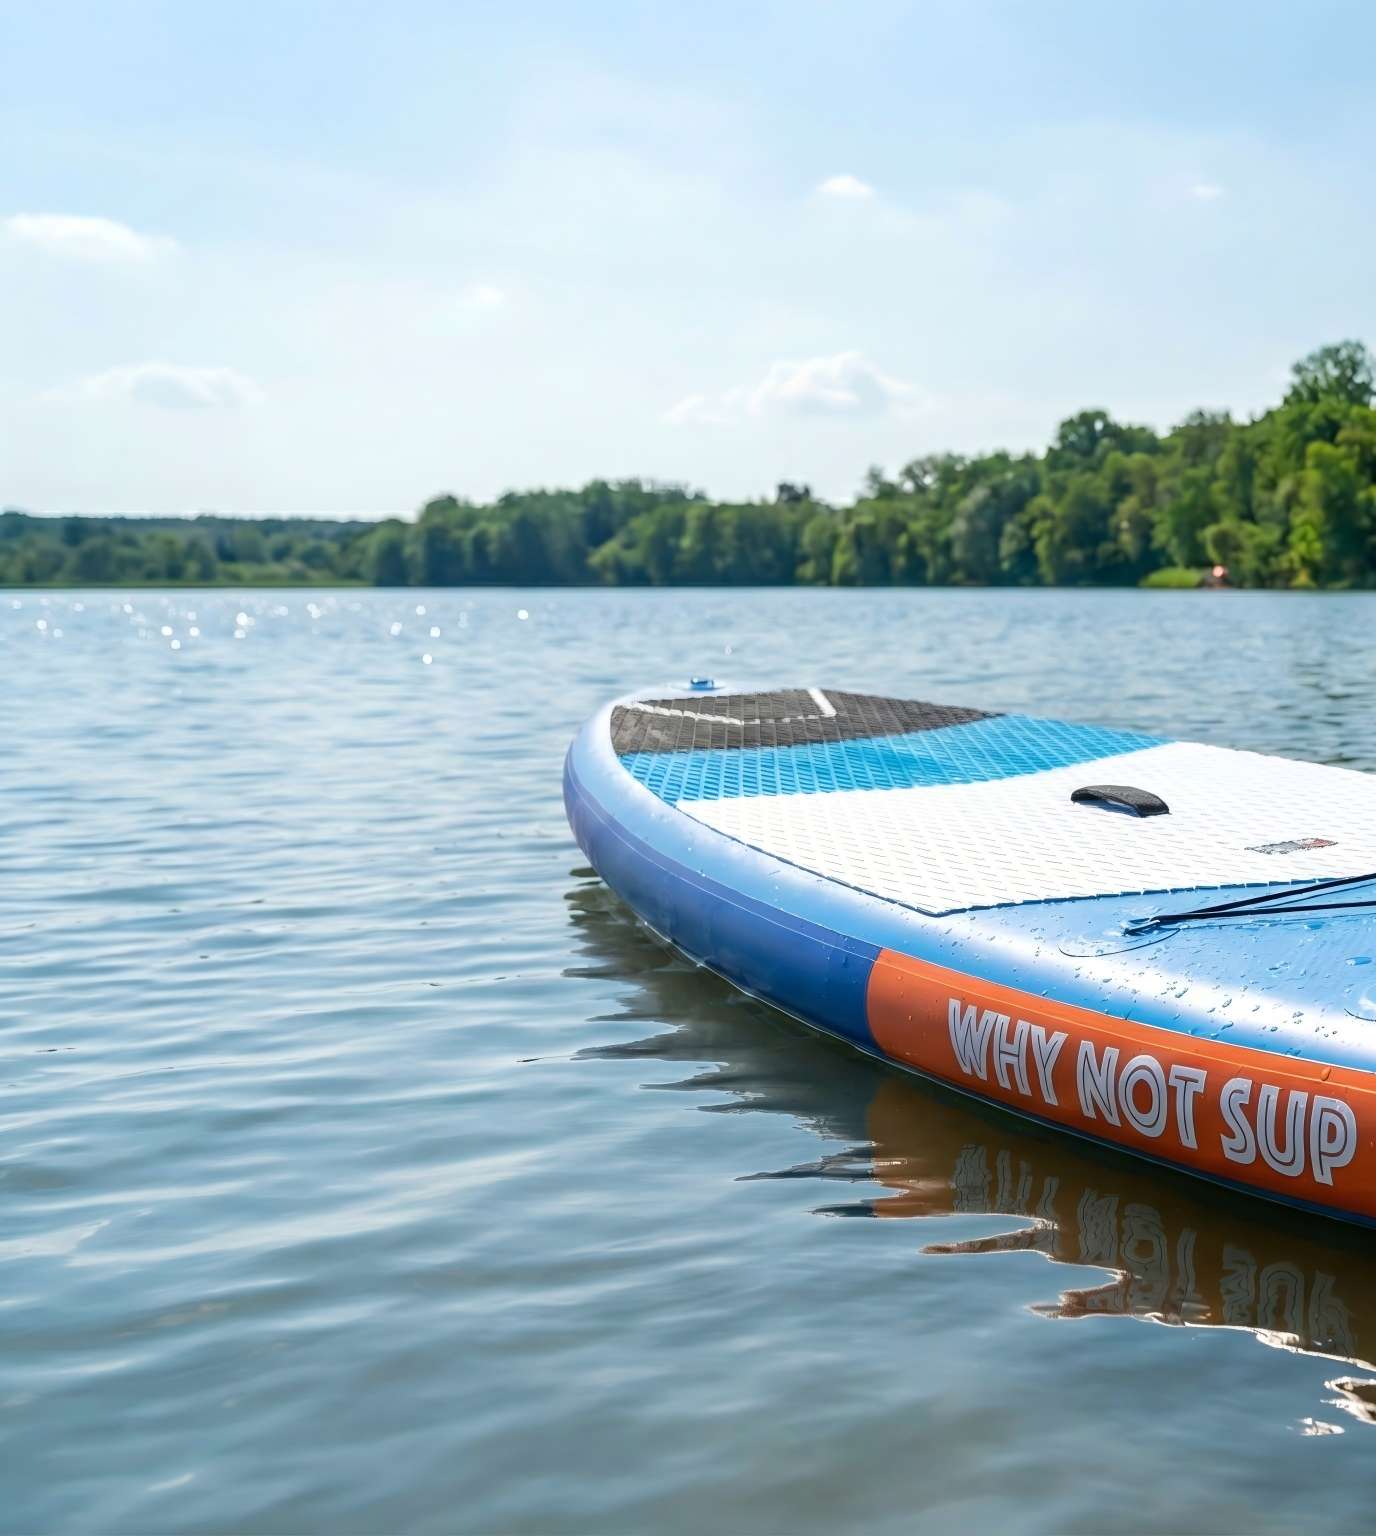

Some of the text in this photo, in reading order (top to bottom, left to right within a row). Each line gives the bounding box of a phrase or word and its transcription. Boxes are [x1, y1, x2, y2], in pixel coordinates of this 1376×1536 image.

[948, 998, 1357, 1186] WHY NOT SUP
